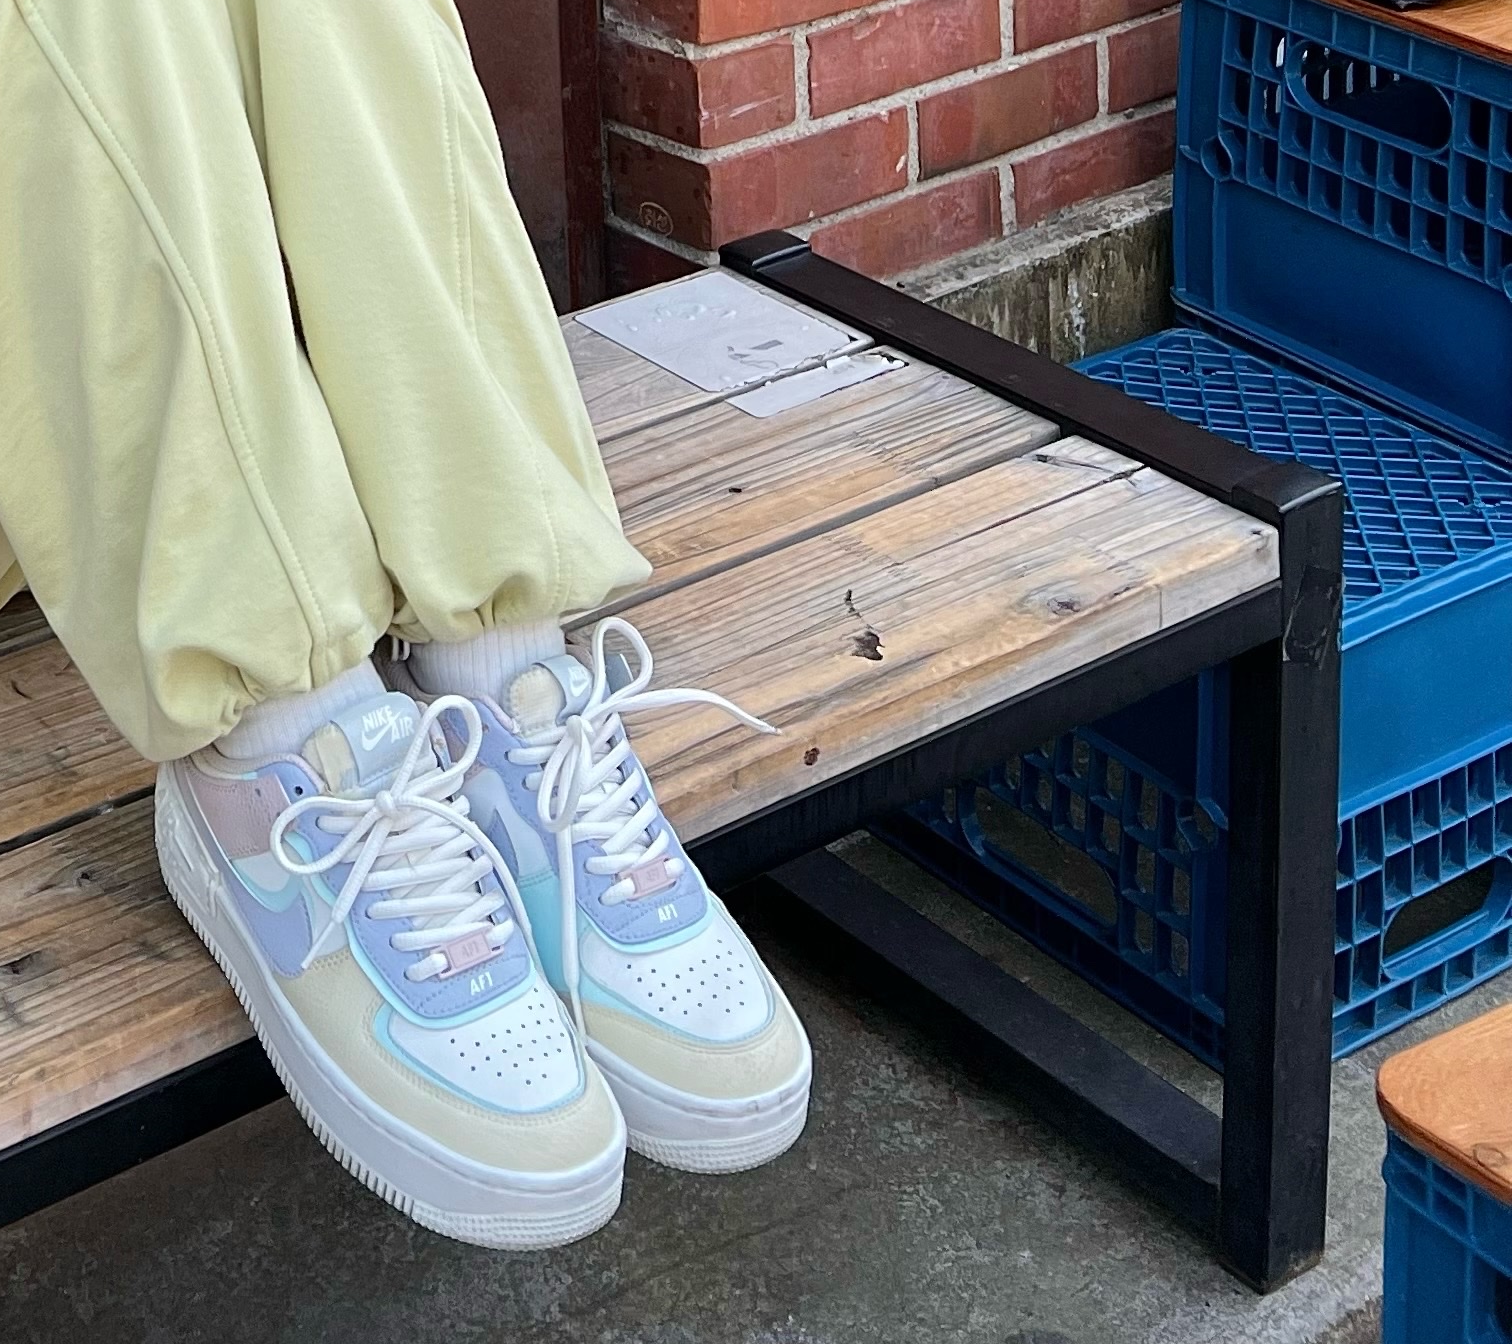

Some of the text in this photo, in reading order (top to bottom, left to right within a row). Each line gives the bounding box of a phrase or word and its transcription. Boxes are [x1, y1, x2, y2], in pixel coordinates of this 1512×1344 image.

[361, 704, 415, 744] NIKE AIR
[657, 903, 678, 924] AF1
[469, 971, 494, 996] AF1
